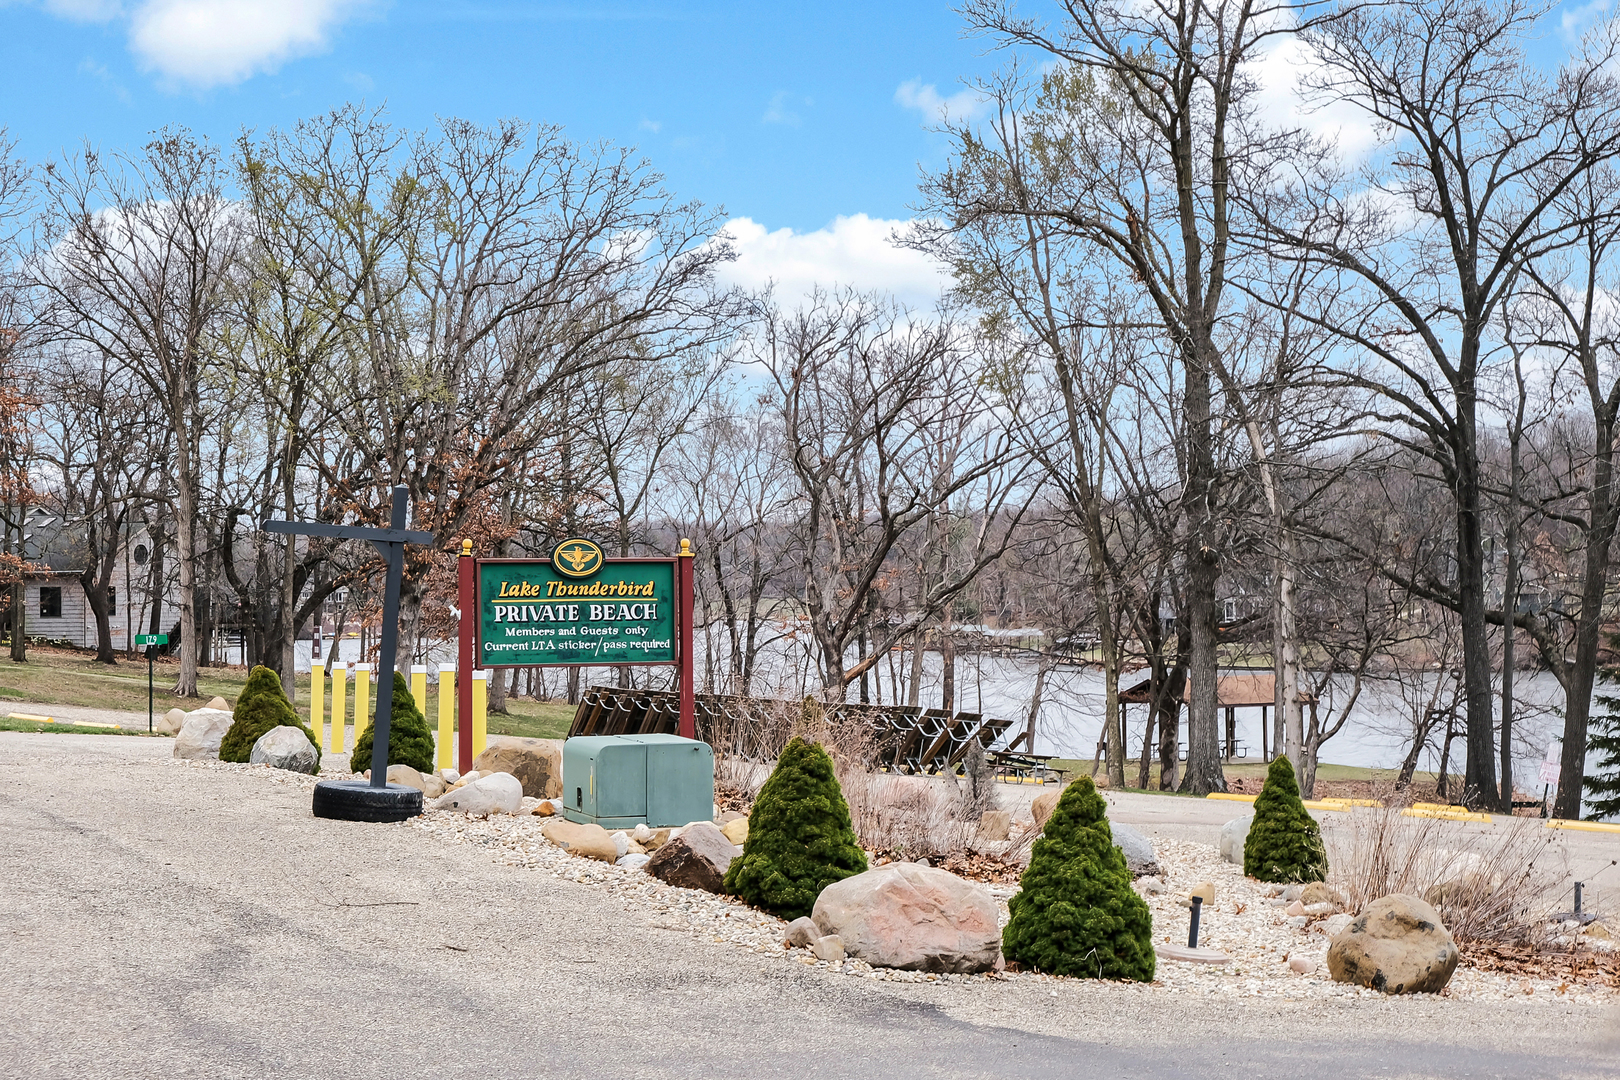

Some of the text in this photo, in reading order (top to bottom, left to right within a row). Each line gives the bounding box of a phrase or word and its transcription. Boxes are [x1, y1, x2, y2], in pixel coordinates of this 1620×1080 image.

[498, 580, 654, 597] Lake Thunderbird
[494, 603, 657, 622] PRIVATE BEACH
[505, 625, 649, 636] Members and Guests only
[145, 635, 158, 643] 179
[484, 642, 529, 651] Current
[531, 640, 556, 650] LTA
[630, 639, 670, 652] required
